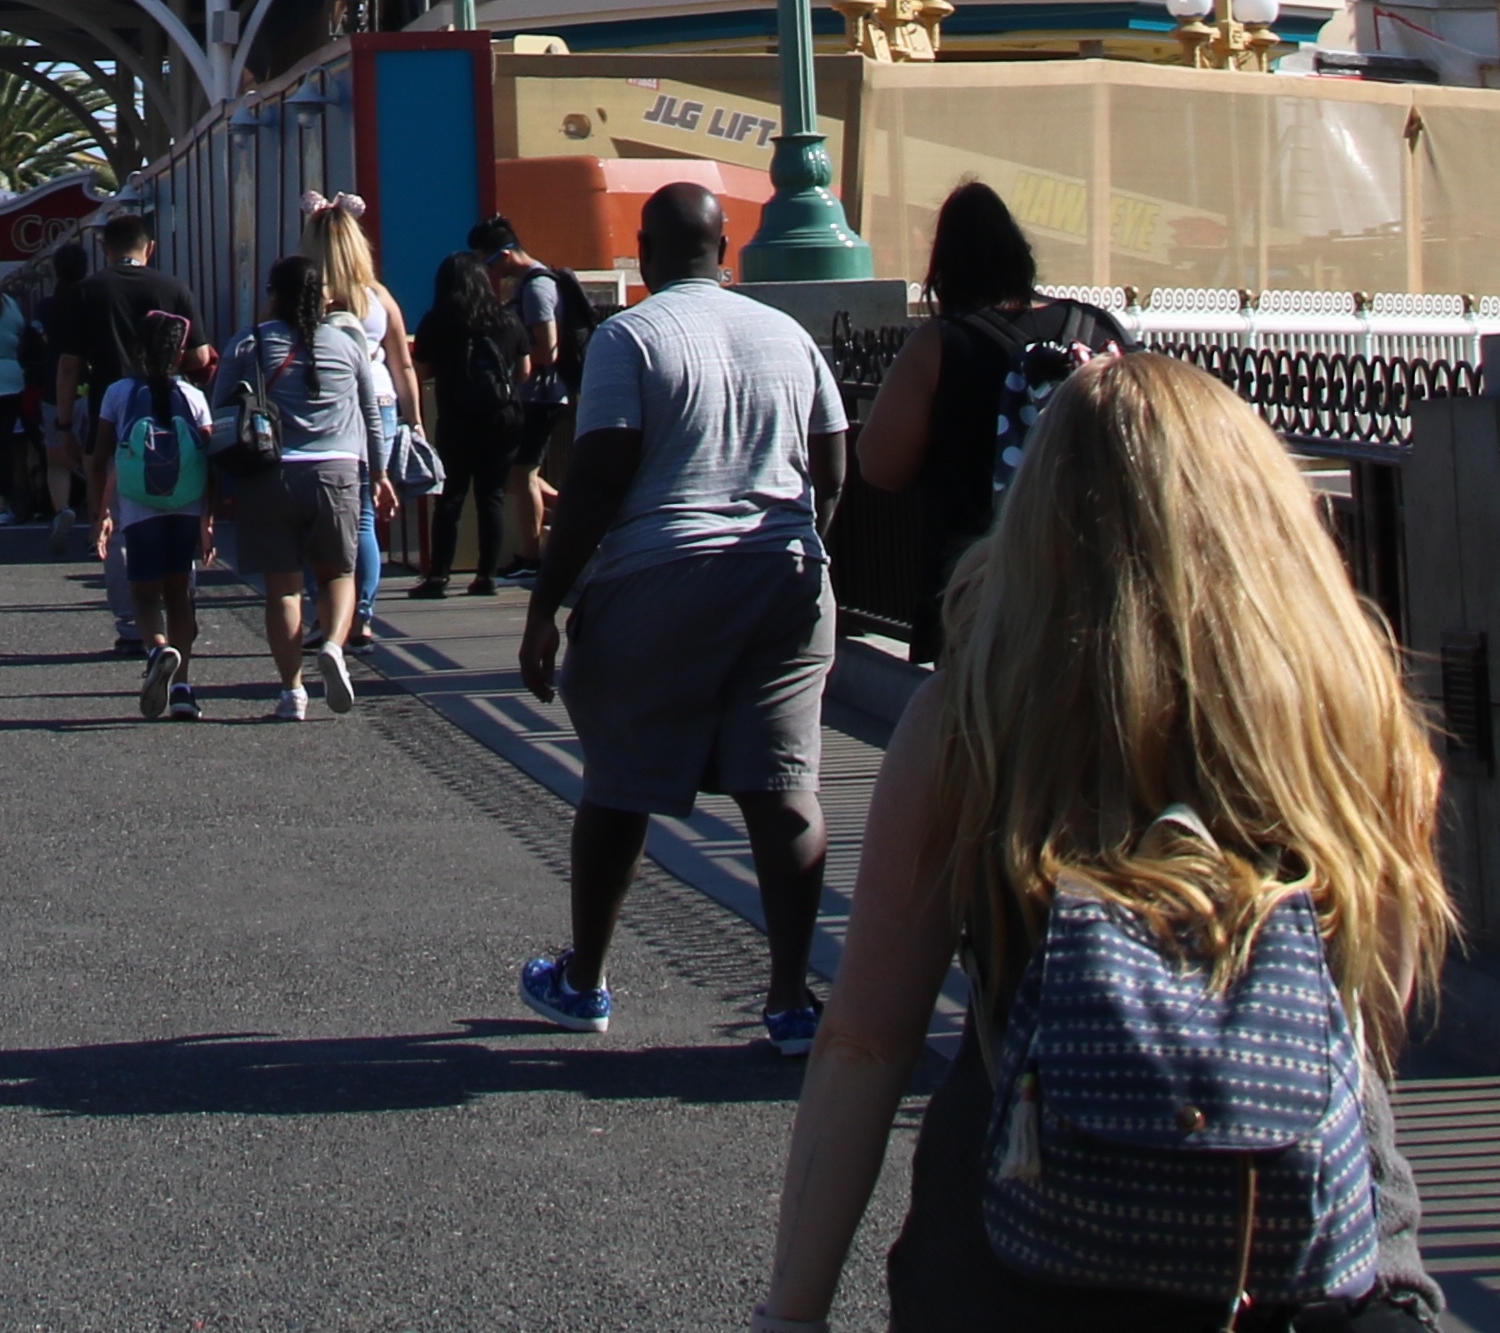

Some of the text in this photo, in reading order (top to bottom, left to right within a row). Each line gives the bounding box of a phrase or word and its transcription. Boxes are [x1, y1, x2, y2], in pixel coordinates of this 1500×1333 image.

[643, 94, 777, 148] JLG LIFT
[1009, 170, 1162, 252] HAWEYE
